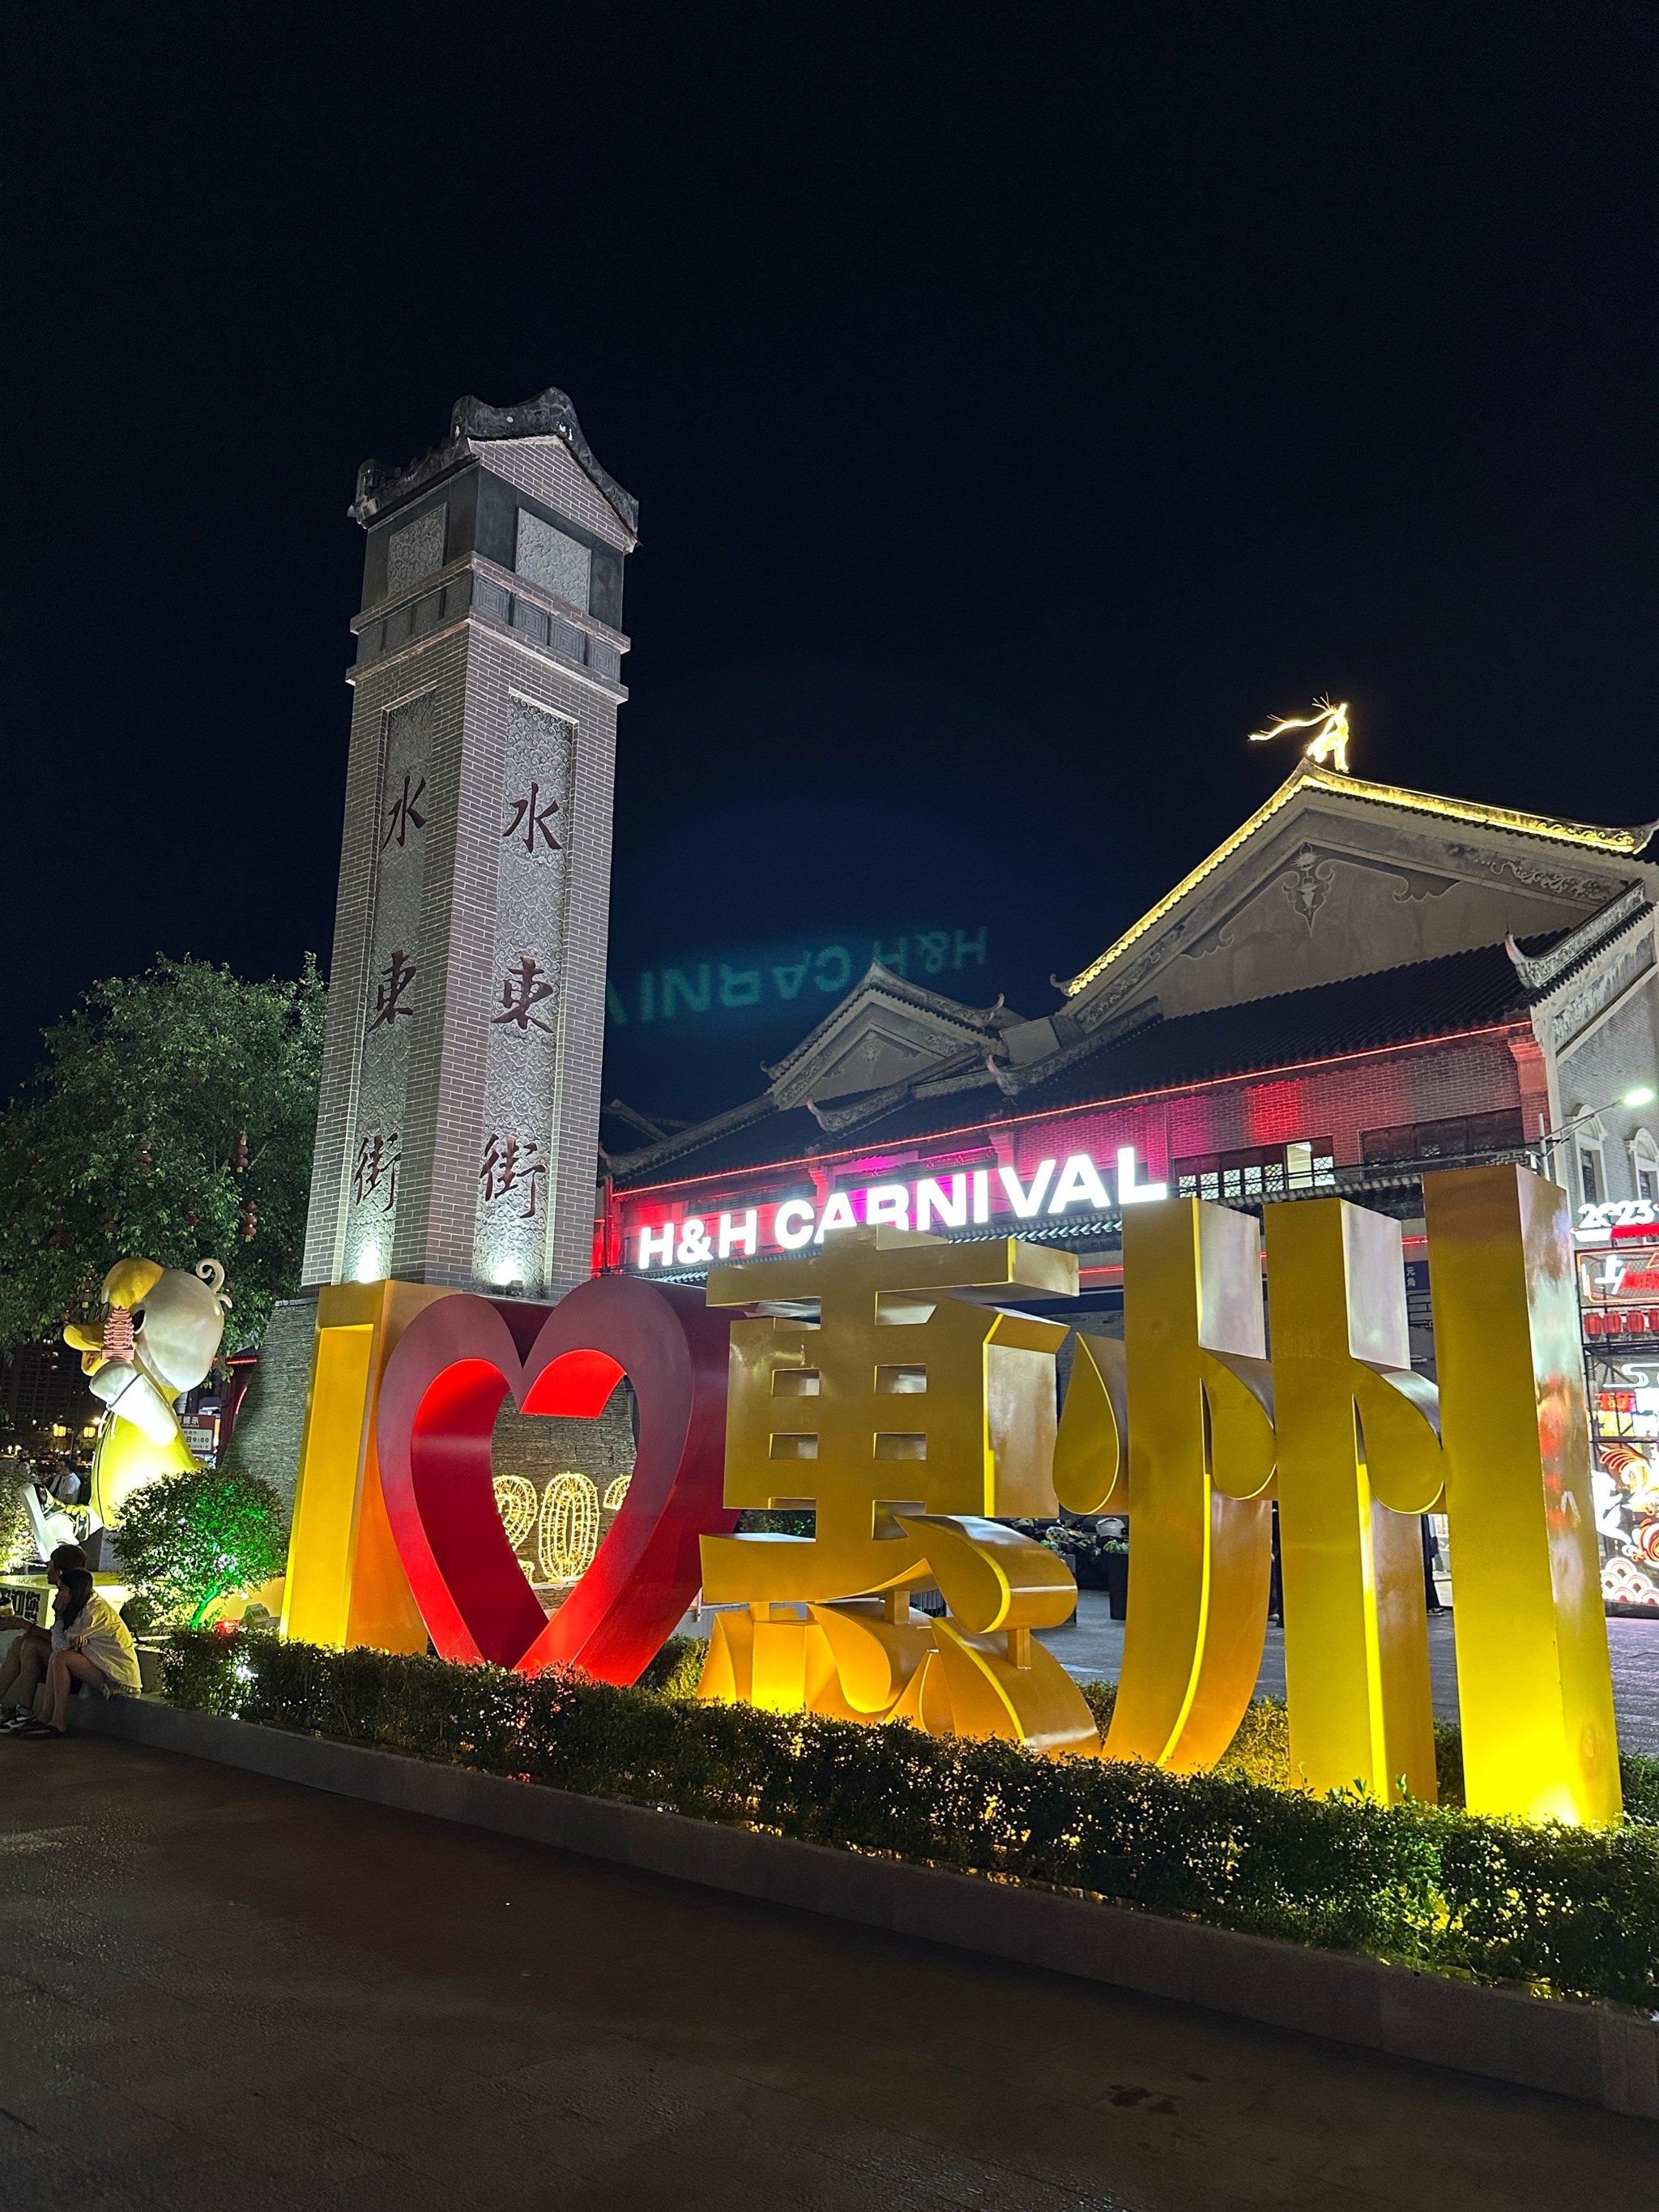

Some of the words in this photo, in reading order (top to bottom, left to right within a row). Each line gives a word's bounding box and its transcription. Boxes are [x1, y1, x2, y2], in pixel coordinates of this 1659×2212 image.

[476, 782, 565, 1218] 水東街
[638, 1209, 758, 1270] H&H
[774, 1146, 1168, 1250] CARNIVAL
[1577, 1200, 1655, 1228] 2023
[493, 1471, 633, 1585] 20
[697, 1164, 1623, 1830] 惠州
